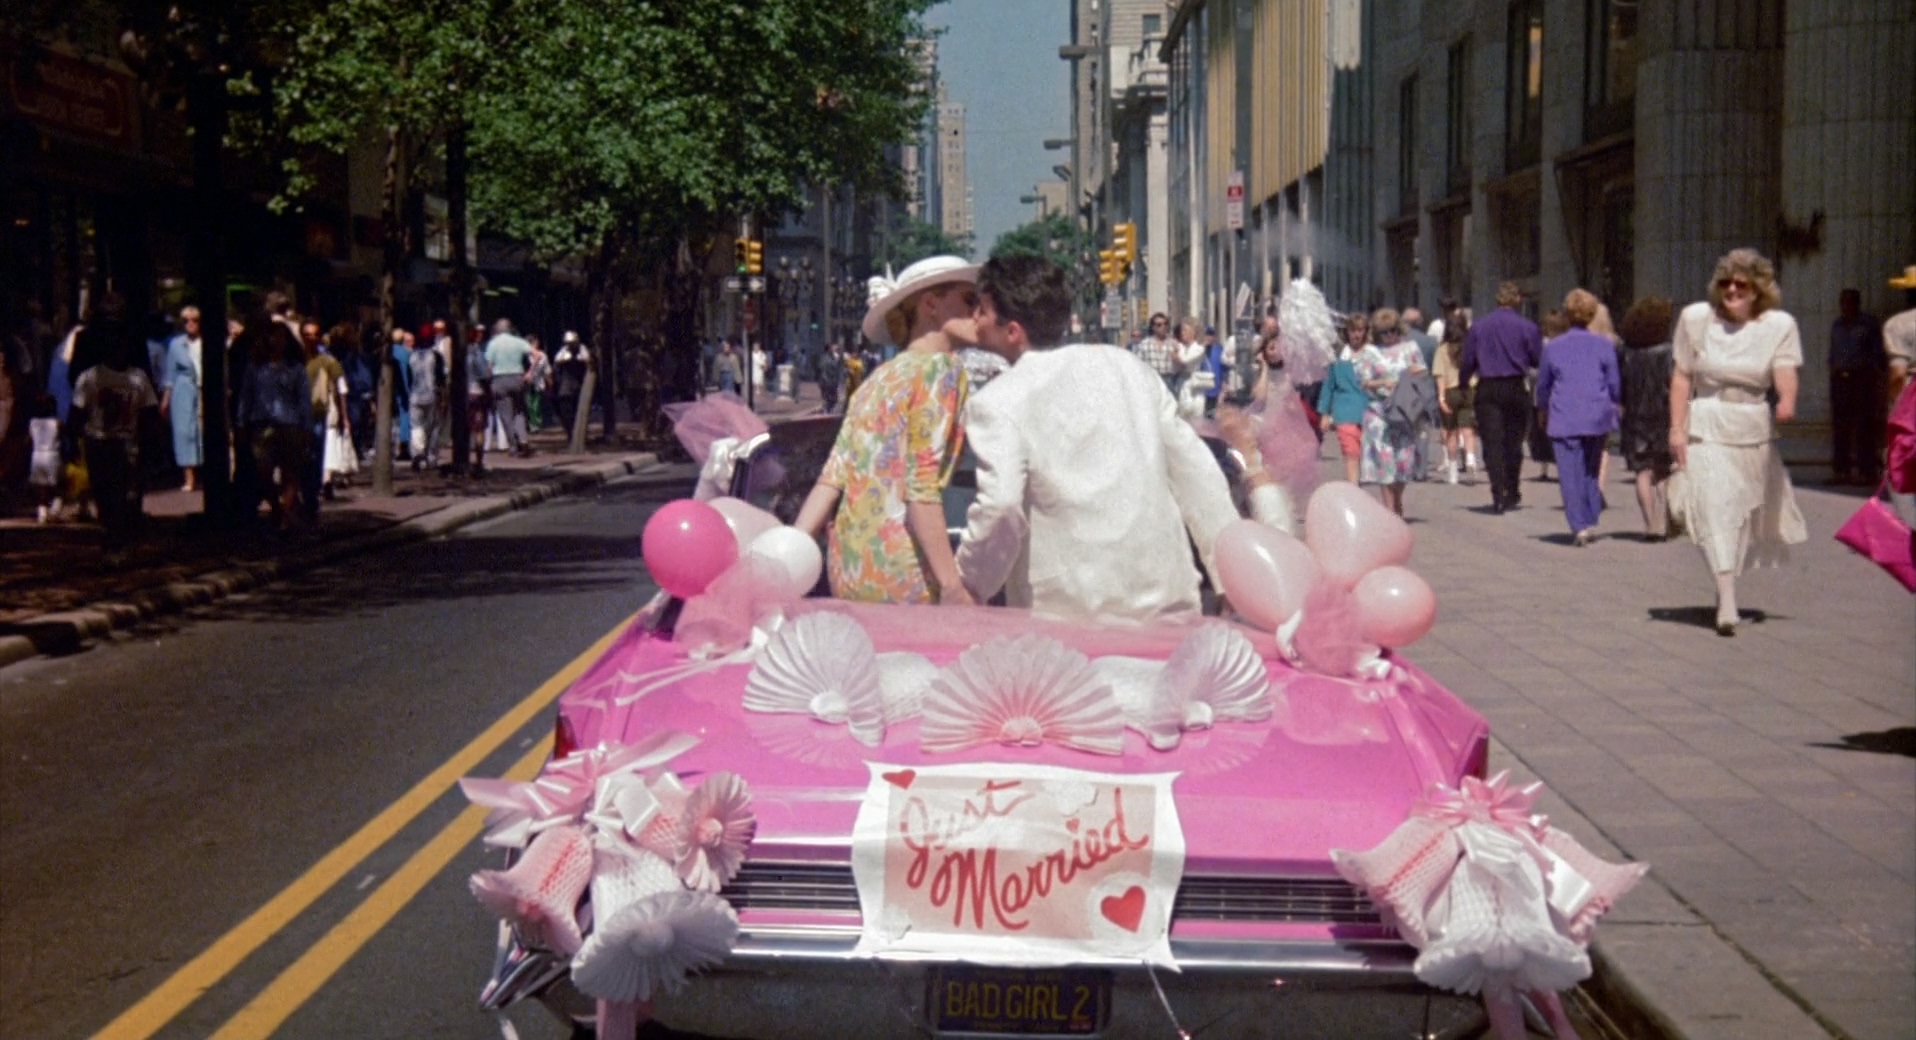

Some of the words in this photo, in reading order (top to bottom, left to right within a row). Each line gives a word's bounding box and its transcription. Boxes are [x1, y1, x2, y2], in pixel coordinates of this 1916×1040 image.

[930, 787, 1149, 929] Married
[945, 981, 1001, 1019] BAD
[1005, 984, 1068, 1021] GIRL
[1071, 985, 1091, 1021] 2
